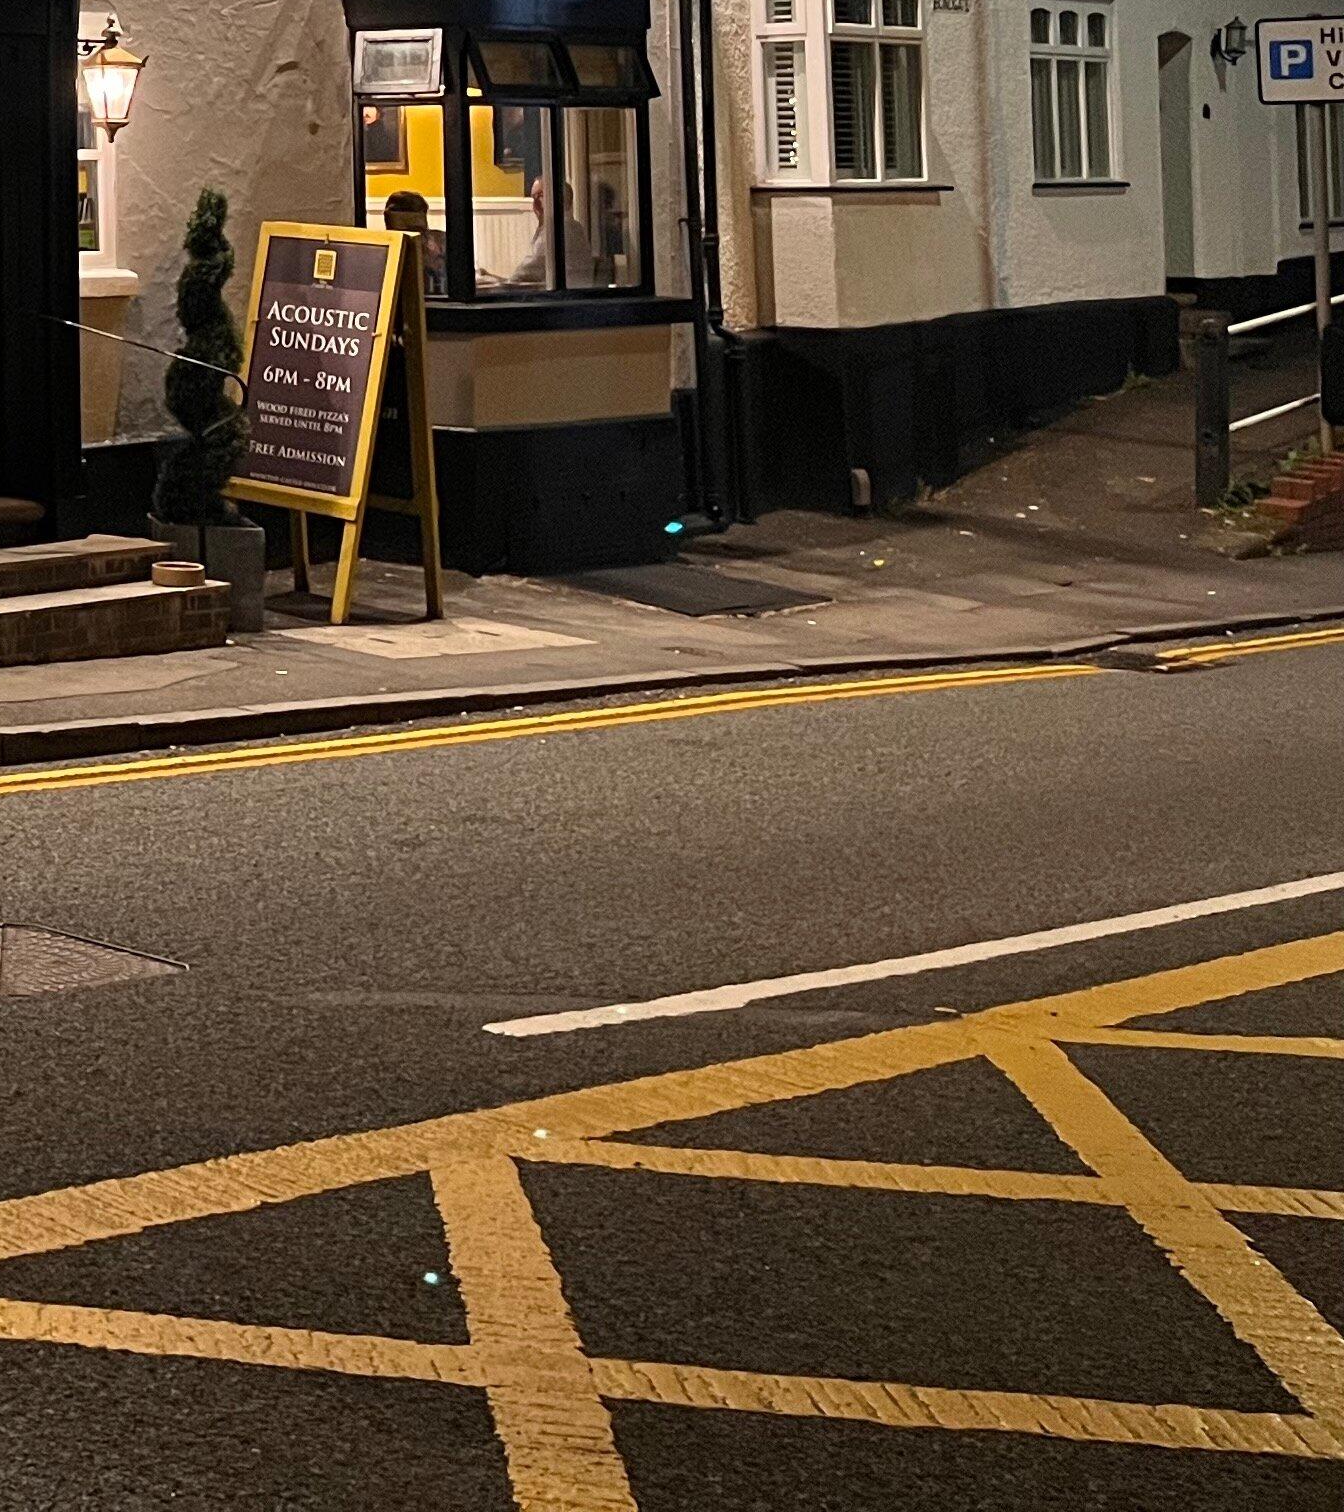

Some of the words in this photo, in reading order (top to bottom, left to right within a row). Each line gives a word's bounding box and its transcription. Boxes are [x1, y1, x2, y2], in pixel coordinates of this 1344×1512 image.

[1279, 44, 1307, 76] P
[266, 300, 370, 331] ACOUSTIC
[269, 326, 360, 357] SUNDAYS
[263, 365, 298, 386] 6PM
[314, 371, 351, 393] 8PM
[256, 399, 288, 414] WOOD
[289, 406, 317, 419] FIRED
[249, 439, 276, 456] FREE
[276, 445, 346, 467] ADMISSION
